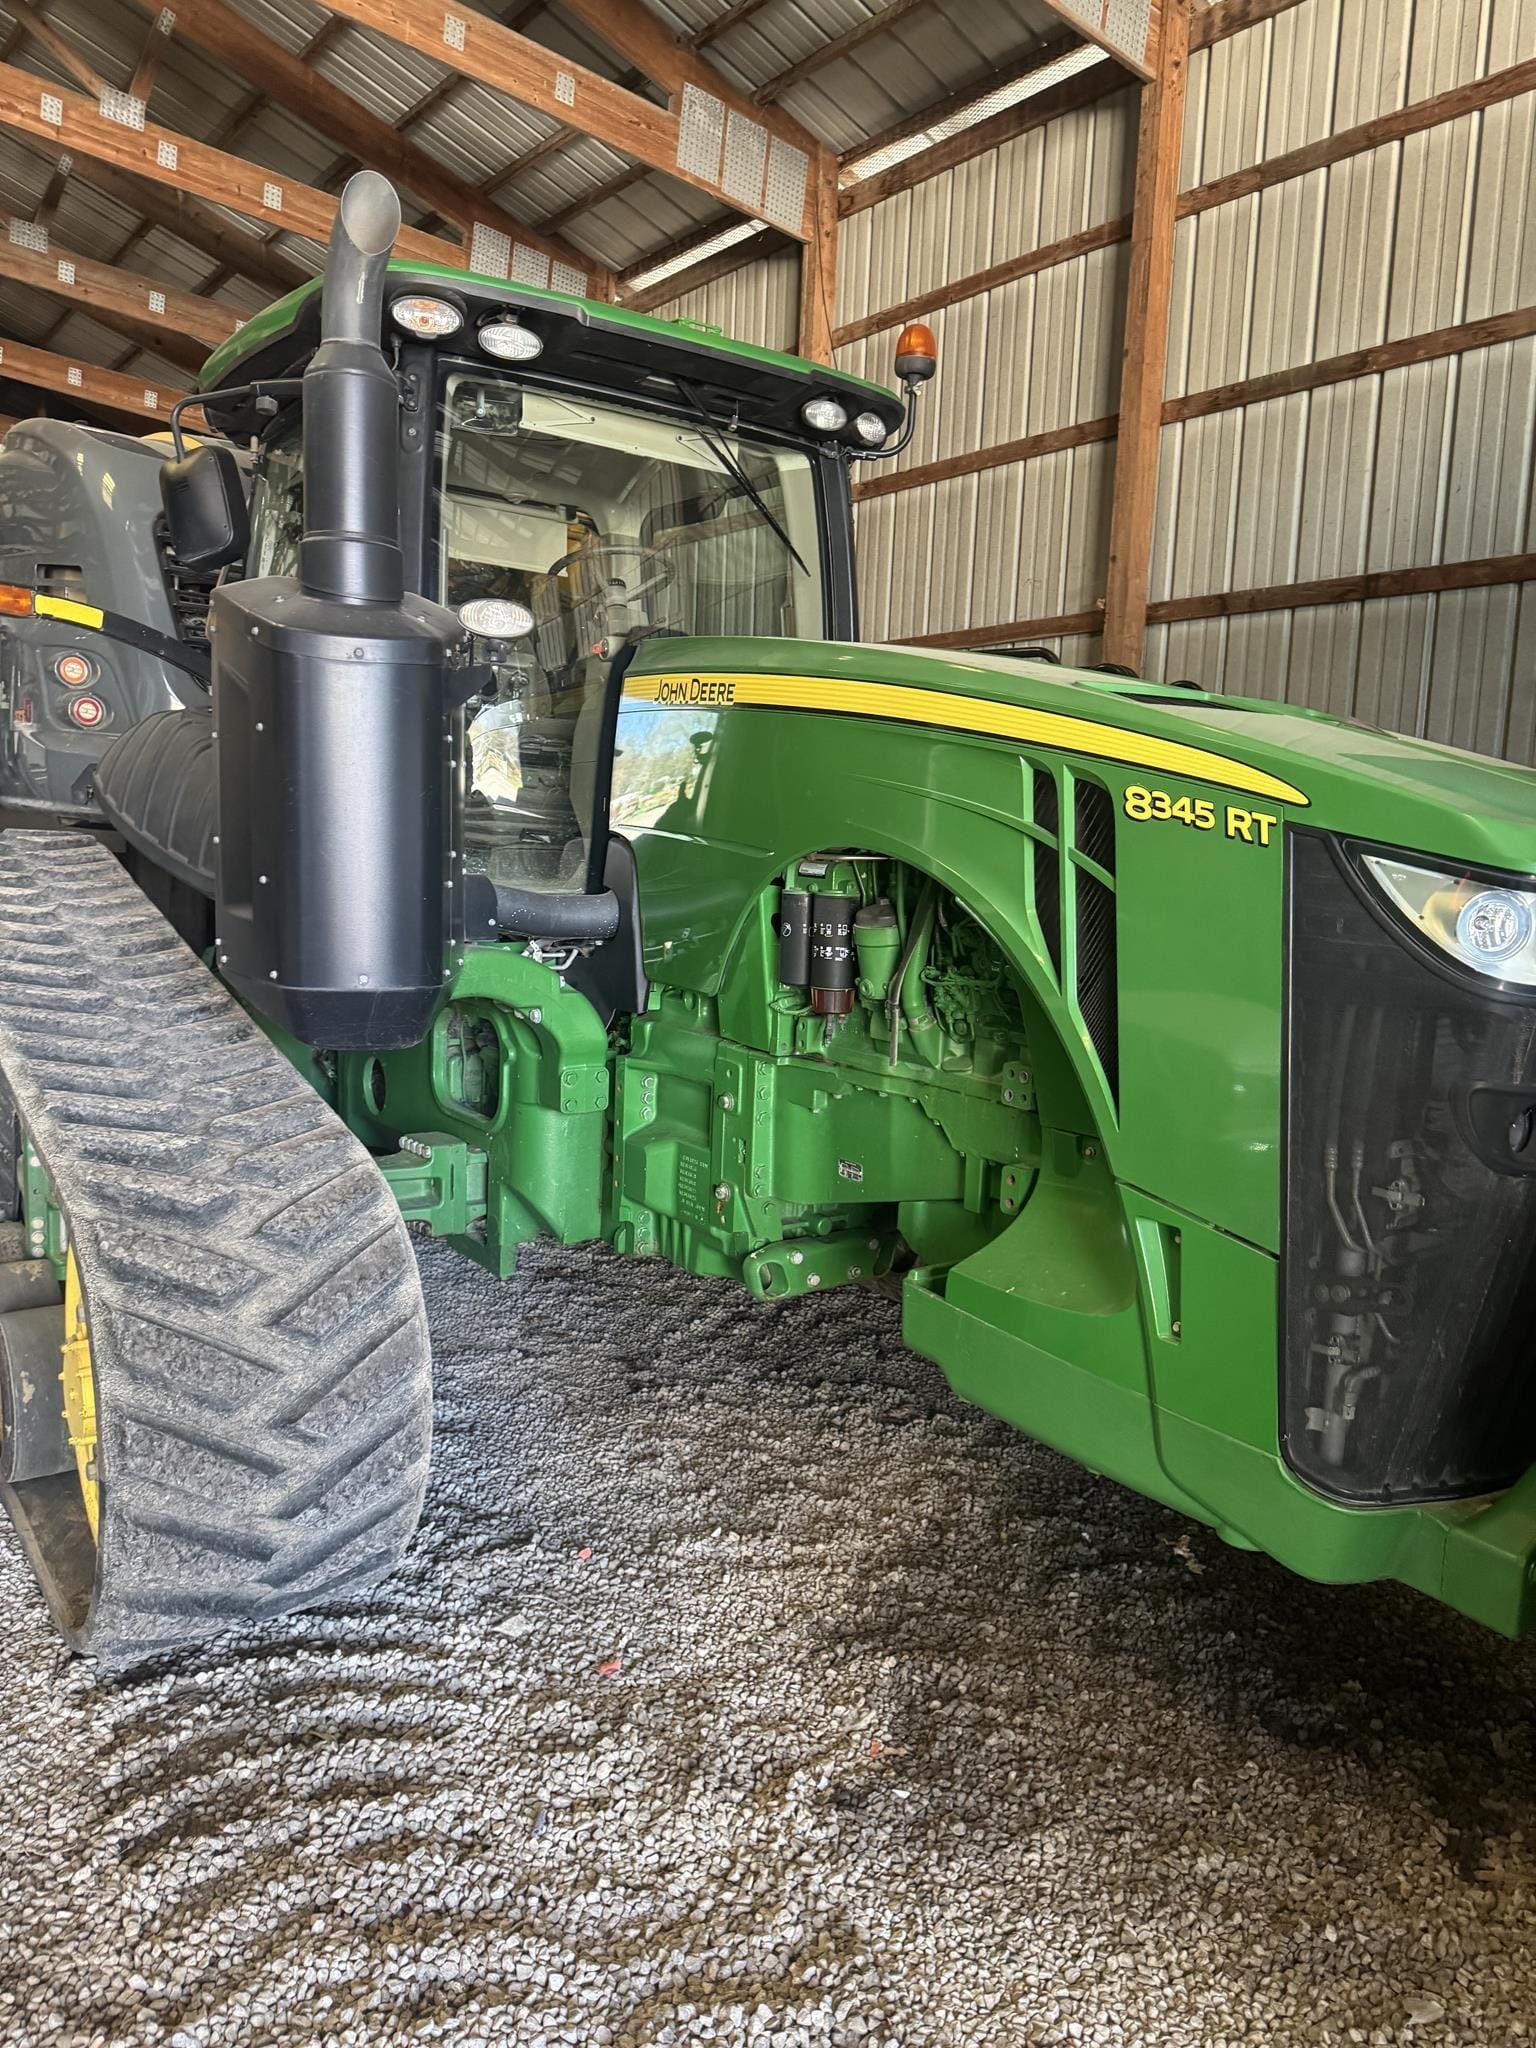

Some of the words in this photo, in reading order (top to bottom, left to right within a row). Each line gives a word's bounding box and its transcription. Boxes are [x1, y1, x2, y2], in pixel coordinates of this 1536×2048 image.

[653, 679, 688, 703] JOHN
[689, 678, 736, 702] DEERE
[1124, 784, 1216, 831] 8345
[1225, 805, 1278, 848] RT
